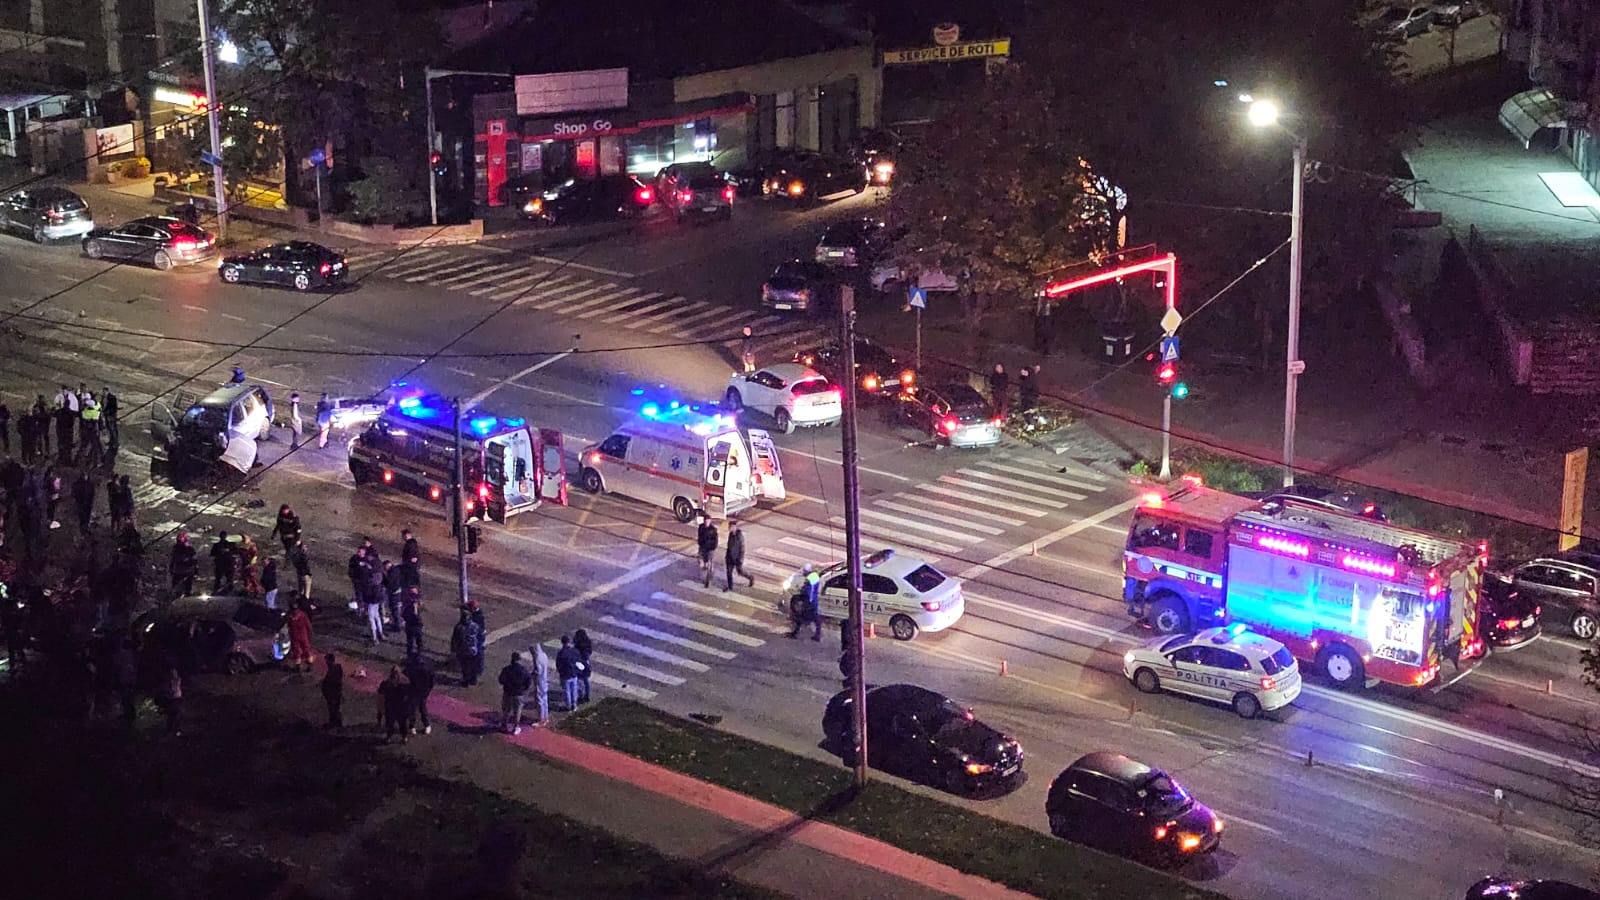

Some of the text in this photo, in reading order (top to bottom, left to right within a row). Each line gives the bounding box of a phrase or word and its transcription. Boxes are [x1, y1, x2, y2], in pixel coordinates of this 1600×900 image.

[899, 48, 947, 62] SERVICE
[949, 47, 965, 57] DE
[553, 119, 612, 134] Shop Go
[835, 599, 882, 612] POTIA
[1177, 670, 1227, 688] POLITIA
